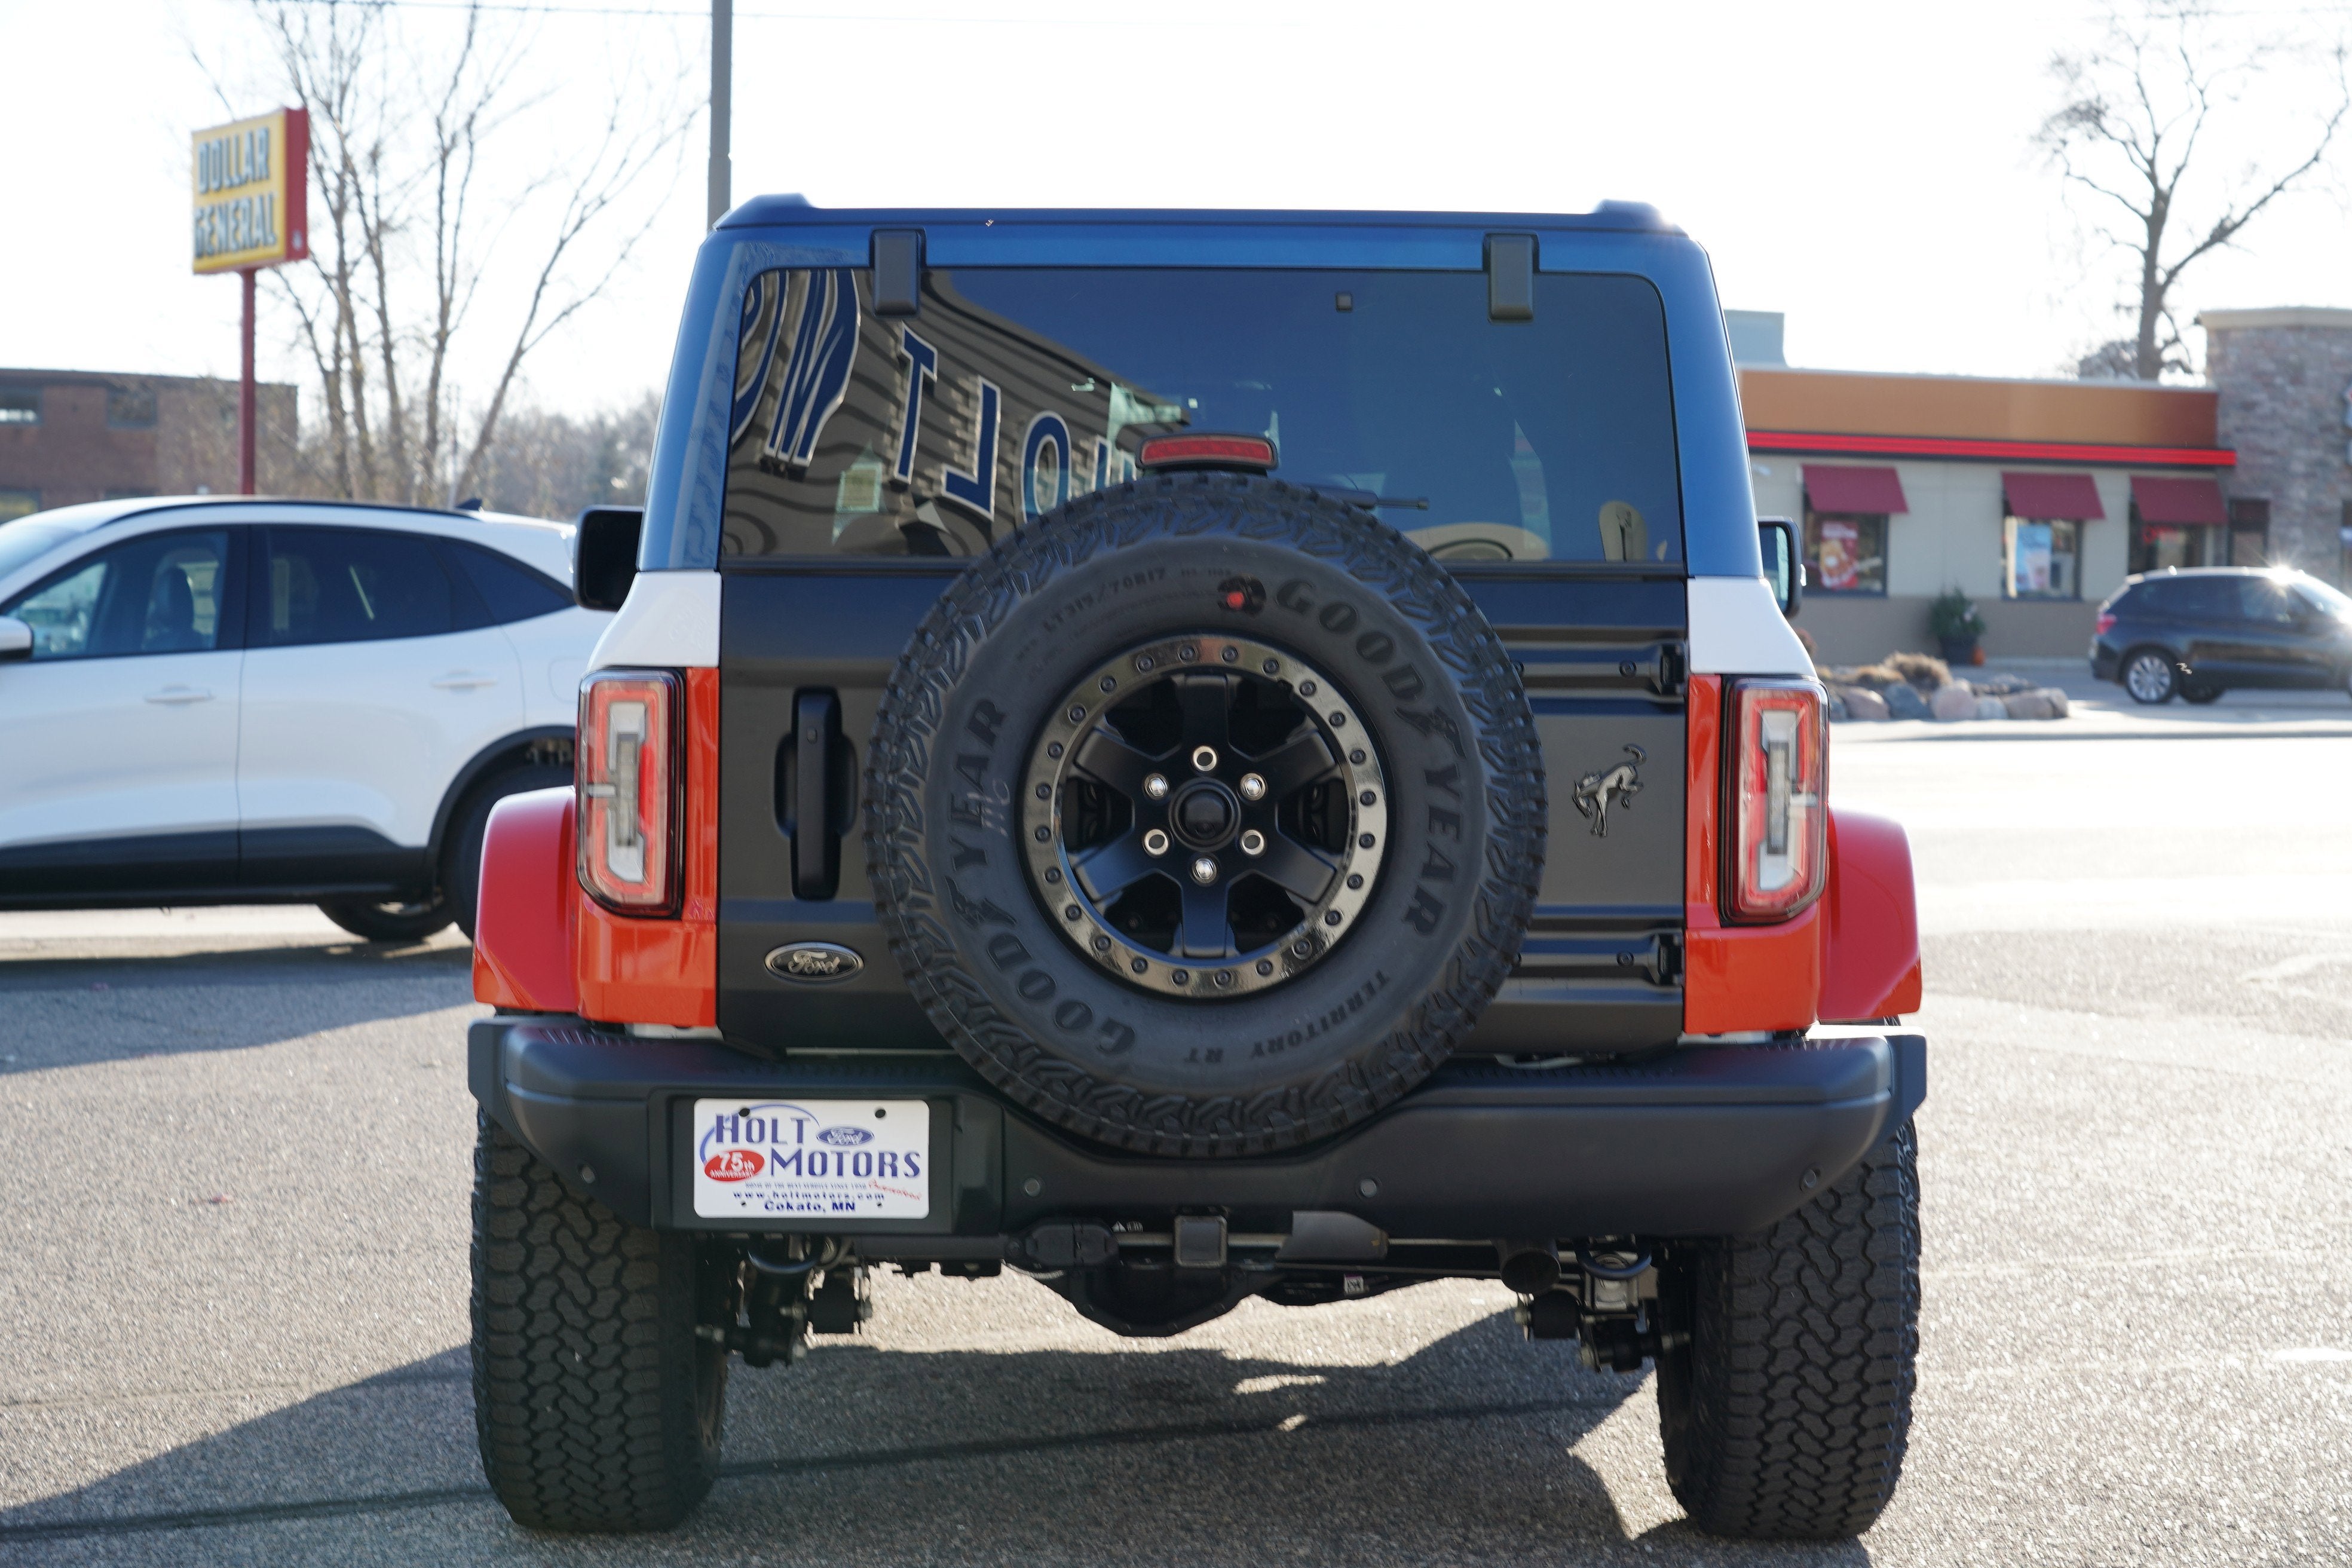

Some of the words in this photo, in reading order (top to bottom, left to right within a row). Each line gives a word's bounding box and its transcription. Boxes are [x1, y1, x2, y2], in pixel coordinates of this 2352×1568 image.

[197, 126, 270, 195] DOLLAR
[193, 191, 278, 259] GENERAL
[1276, 580, 1466, 937] GOODYEAR
[944, 699, 1135, 1055] GOODYEAR
[788, 950, 841, 975] Ford
[1250, 969, 1389, 1058] TERRITORY
[1183, 1048, 1224, 1064] RT
[715, 1113, 811, 1146] HOLT
[826, 1128, 863, 1145] Ford
[718, 1151, 755, 1172] 75th
[770, 1147, 921, 1178] MOTORS
[733, 1190, 885, 1200] www.holtmotors.com
[764, 1200, 826, 1213] Cokato,
[832, 1201, 856, 1212] MN
